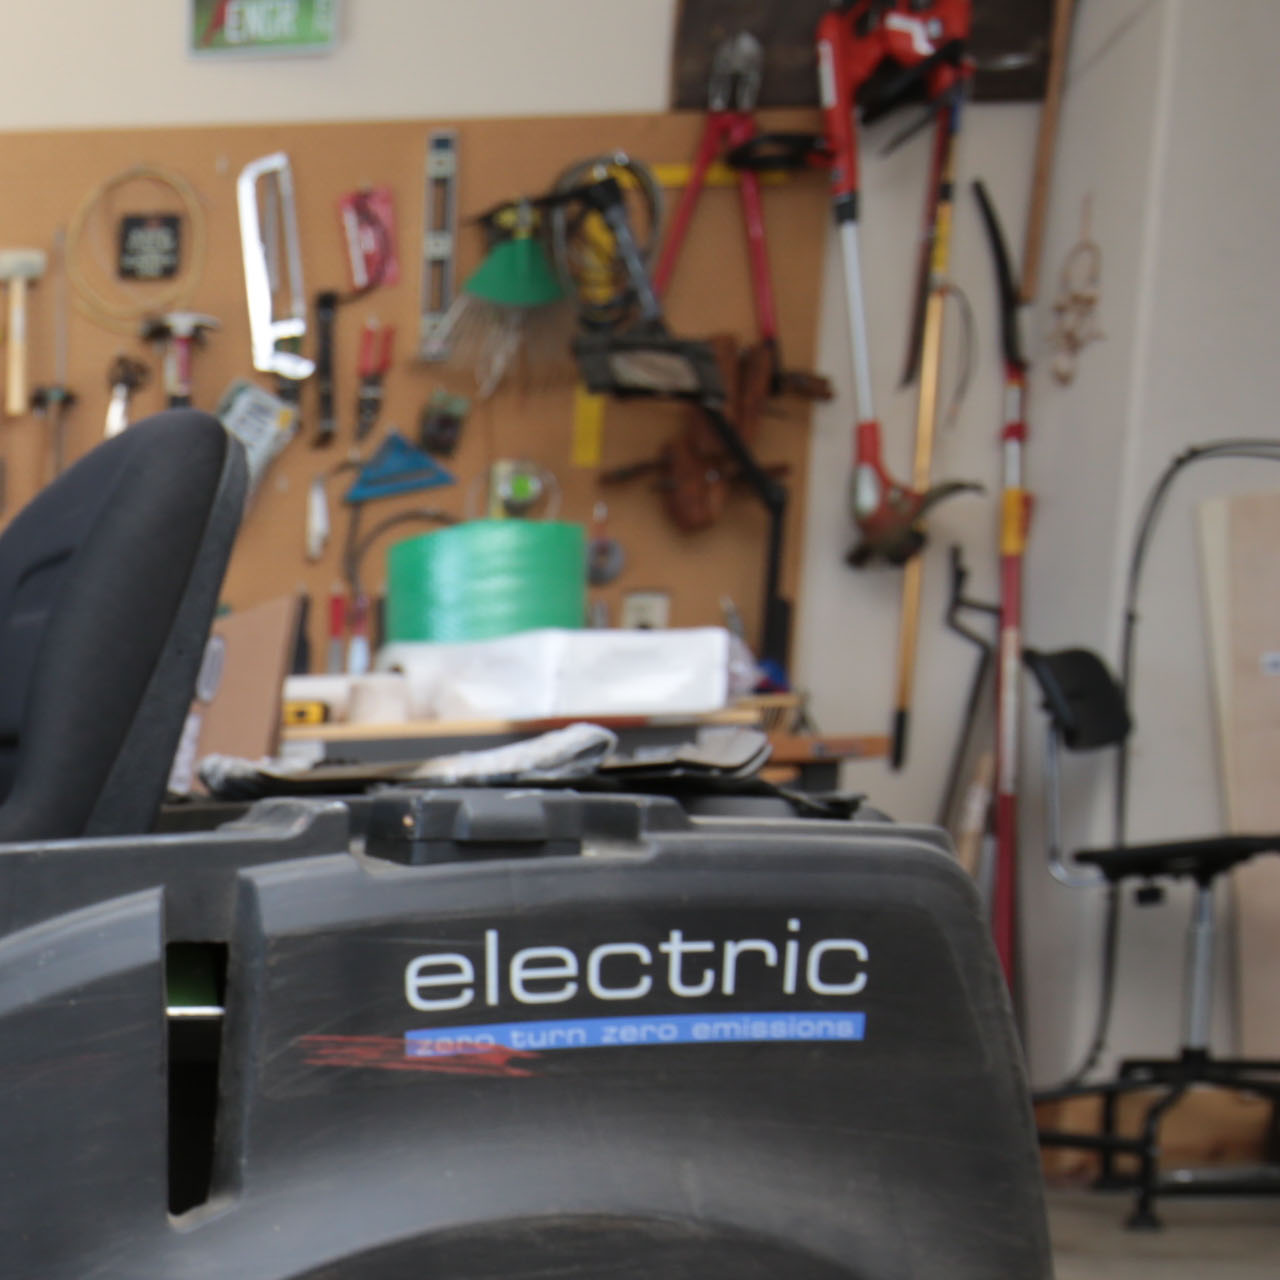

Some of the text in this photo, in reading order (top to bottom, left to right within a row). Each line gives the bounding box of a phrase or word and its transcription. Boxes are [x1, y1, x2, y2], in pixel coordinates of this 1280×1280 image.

[404, 918, 869, 1012] electric
[414, 1016, 855, 1057] zero turn zero emissions
